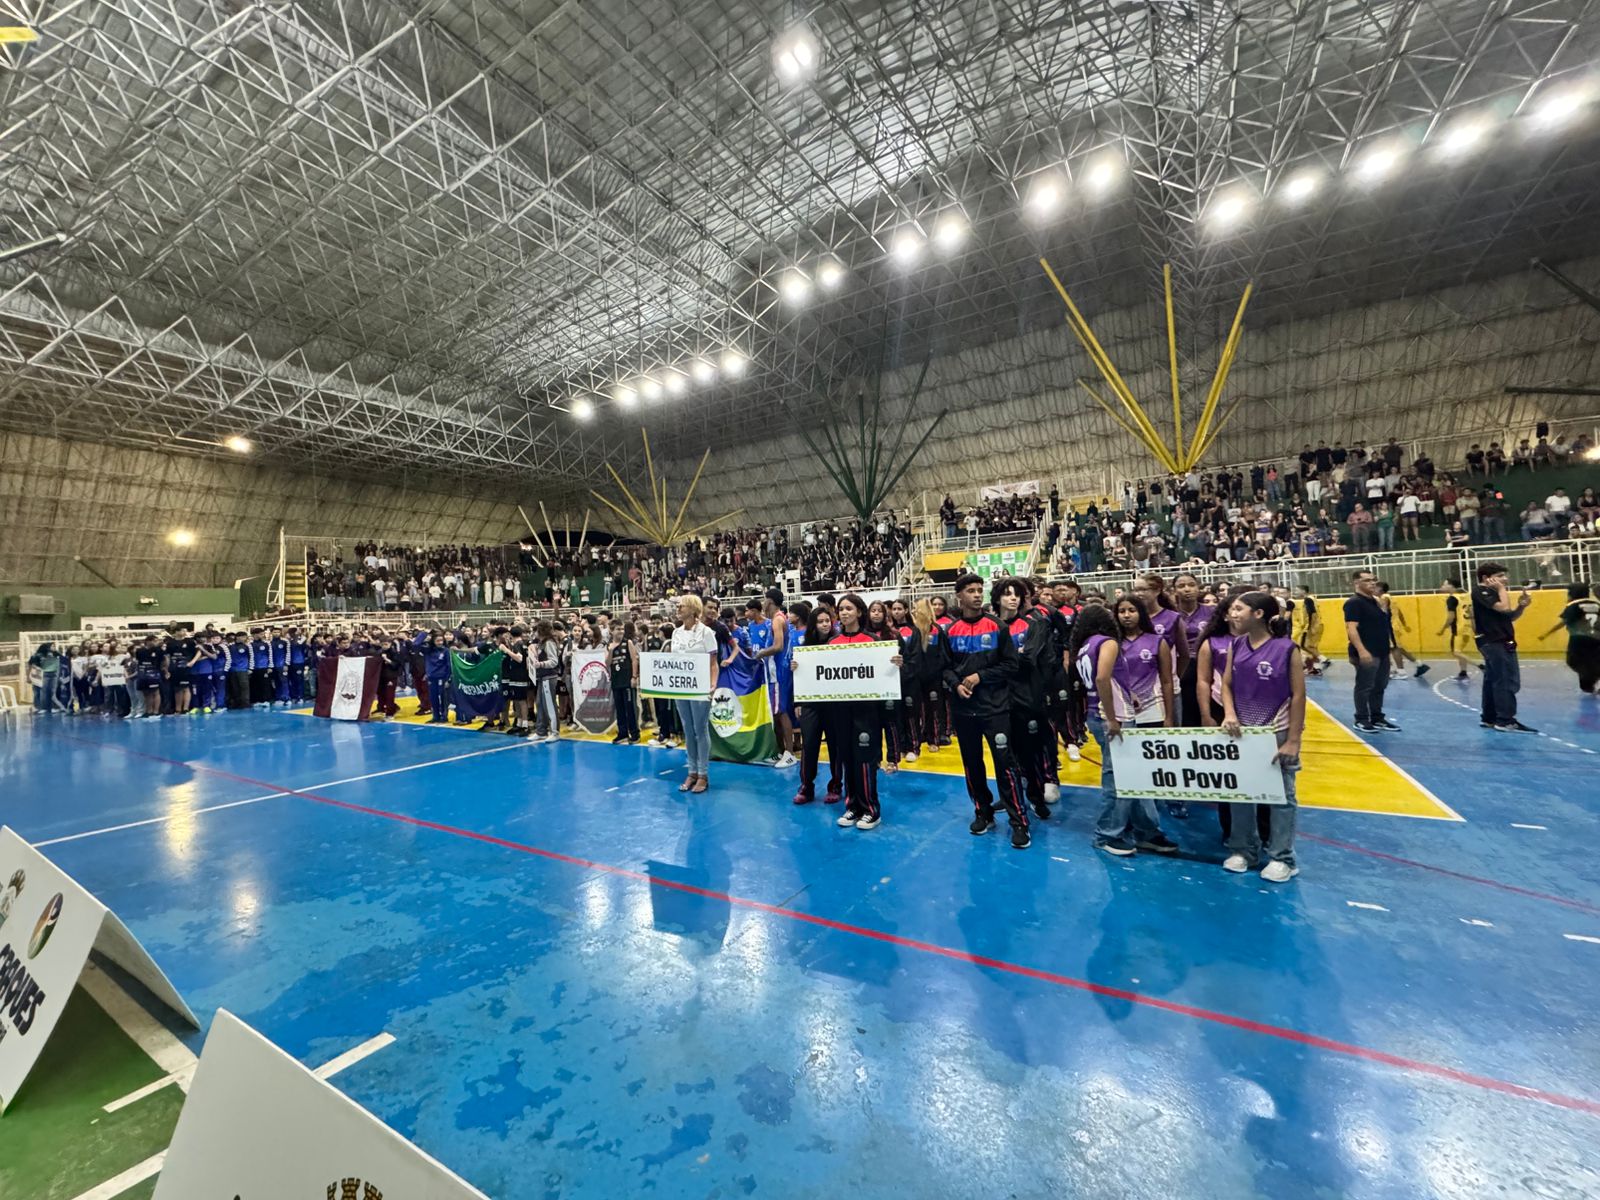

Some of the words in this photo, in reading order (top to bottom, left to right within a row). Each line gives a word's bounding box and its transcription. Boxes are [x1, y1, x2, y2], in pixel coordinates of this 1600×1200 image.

[653, 660, 695, 671] PLANALTO
[816, 663, 874, 681] Poxoréu
[652, 675, 663, 687] DA
[669, 675, 698, 688] SERRA
[1141, 739, 1180, 760] São
[1187, 740, 1240, 761] José
[1152, 768, 1177, 787] do
[1182, 768, 1238, 789] Povo
